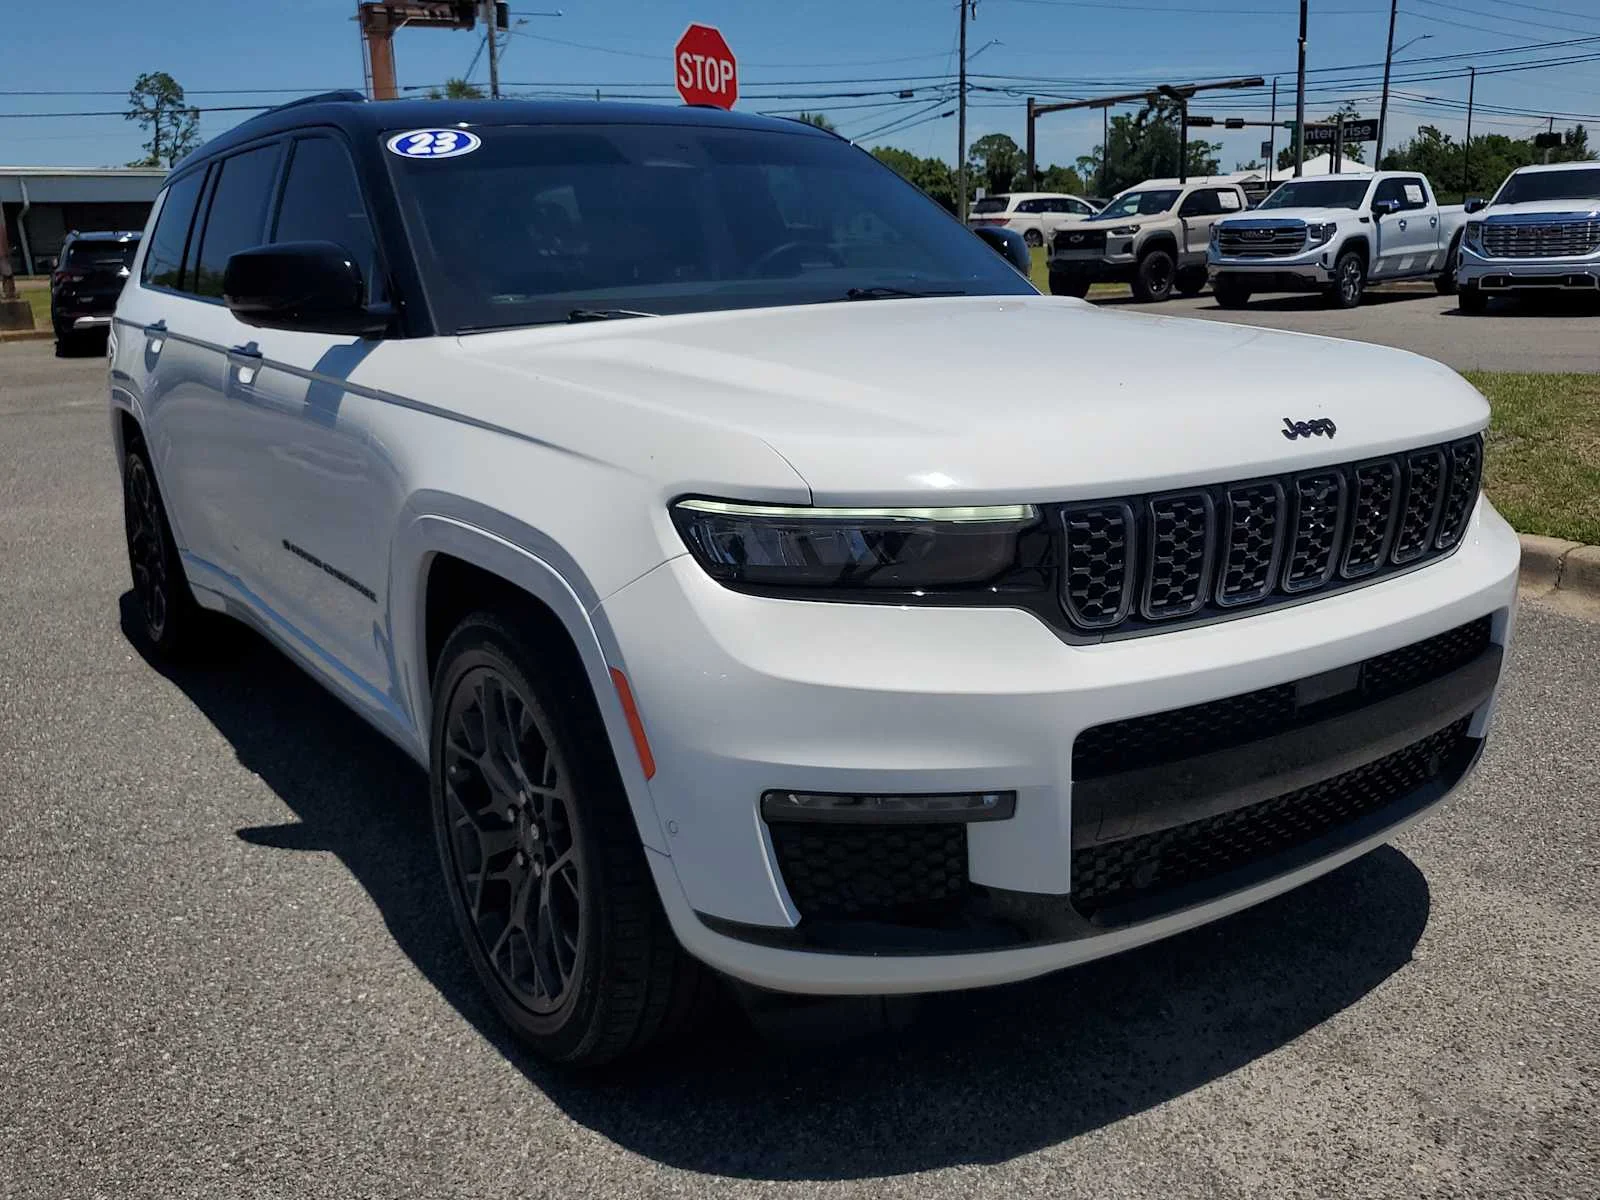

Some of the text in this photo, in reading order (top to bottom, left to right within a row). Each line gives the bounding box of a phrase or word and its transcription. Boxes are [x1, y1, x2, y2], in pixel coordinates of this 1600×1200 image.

[679, 51, 734, 94] STOP
[406, 132, 459, 155] 23
[1281, 417, 1337, 440] Jeep
